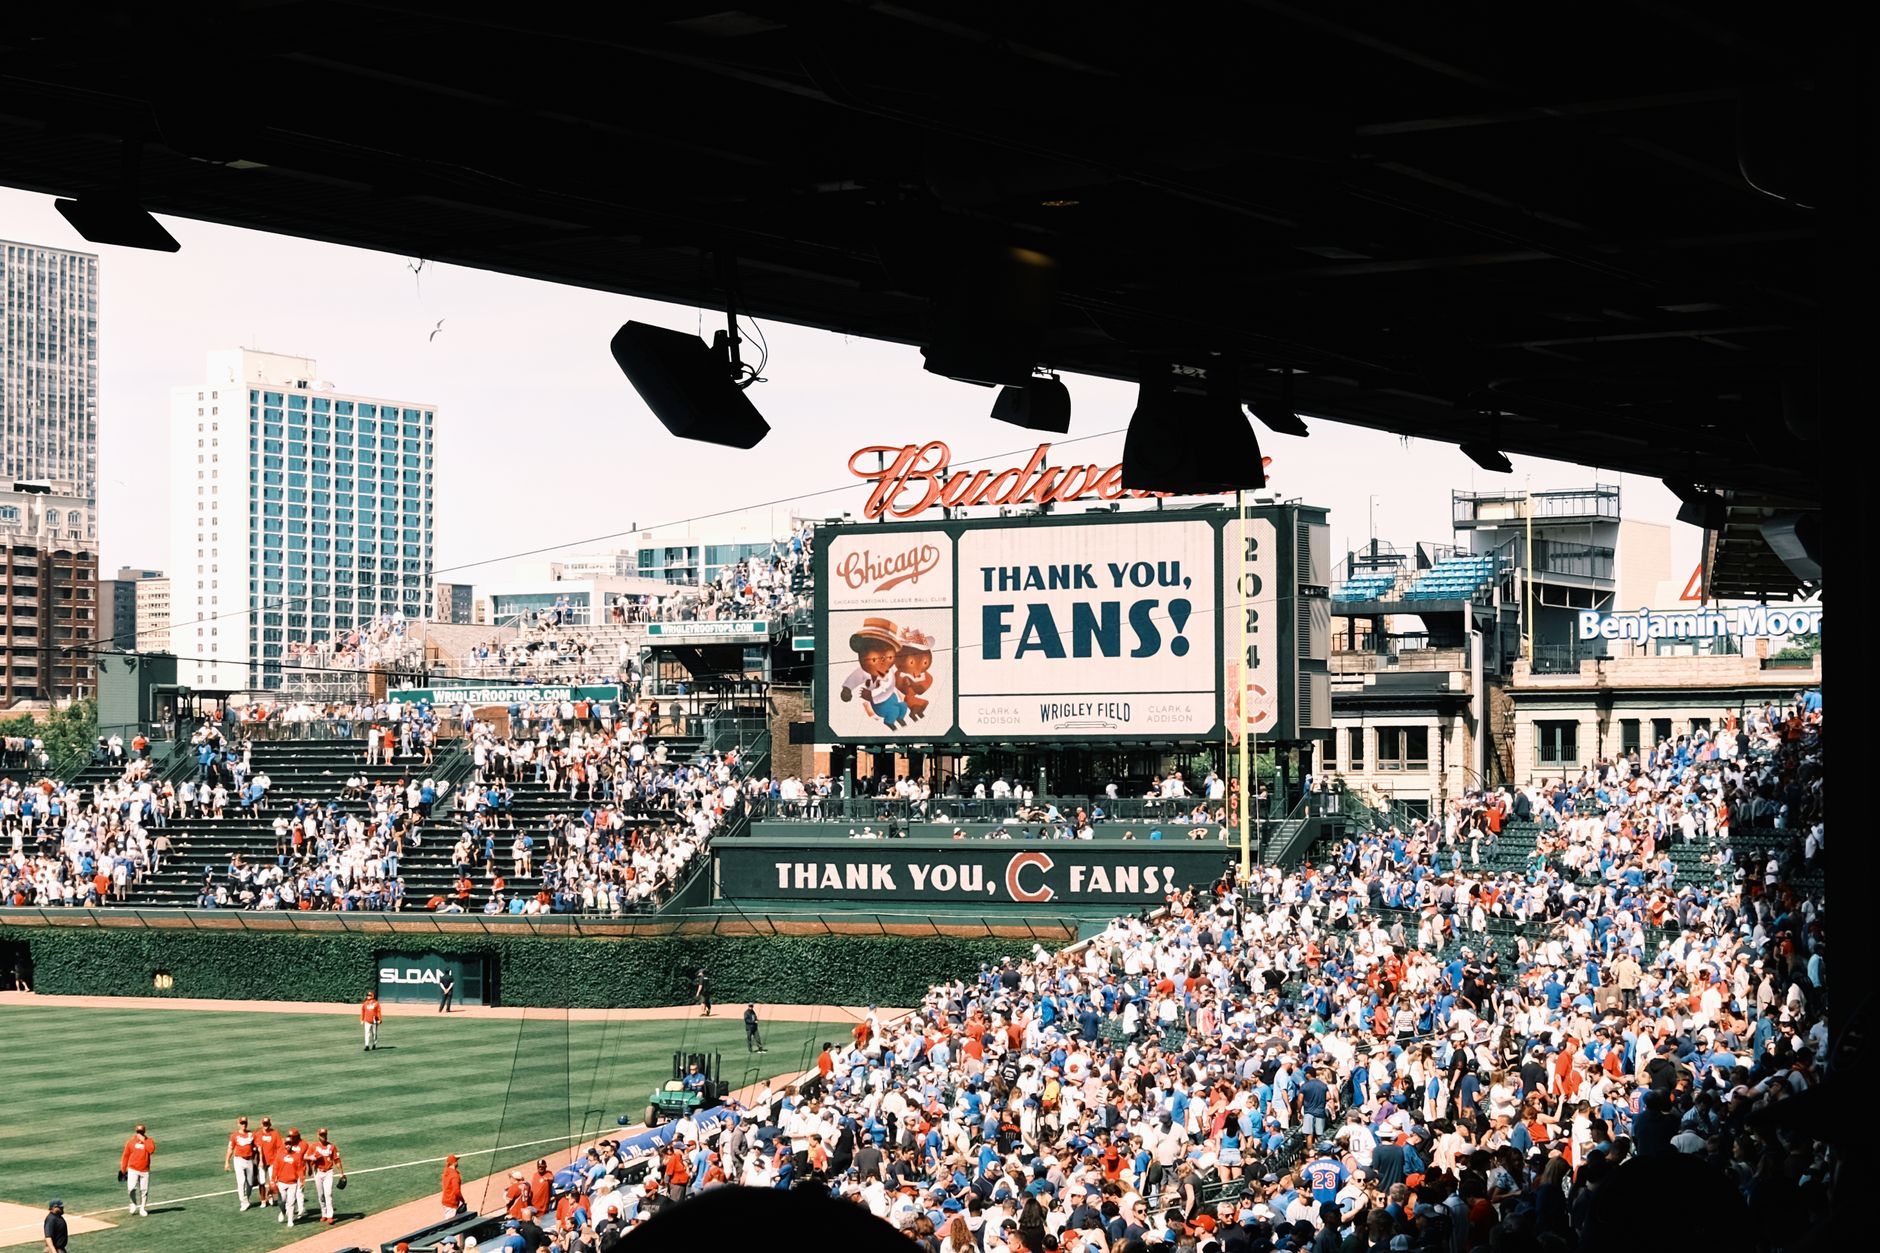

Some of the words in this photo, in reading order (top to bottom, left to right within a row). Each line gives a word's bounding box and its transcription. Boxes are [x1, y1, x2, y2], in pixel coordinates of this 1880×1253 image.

[848, 440, 1272, 520] Budwe
[836, 544, 940, 593] Chicago
[980, 563, 1098, 592] THANK
[1107, 560, 1192, 590] YOU,
[982, 598, 1192, 660] FANS!
[1578, 605, 1728, 647] Benjamin
[1736, 604, 1822, 637] Moor
[432, 688, 571, 703] WRIGLEYROOFTOPS.COM
[978, 707, 1010, 716] CLARK
[1040, 703, 1092, 723] WRIGLEY
[1097, 702, 1131, 722] FIELD
[1146, 714, 1193, 723] ADDISON
[1147, 705, 1182, 714] CLARK
[977, 717, 1021, 725] ADDISON
[775, 862, 897, 891] THANK
[907, 863, 997, 896] YOU,
[1070, 864, 1176, 895] FANS!
[1312, 1171, 1336, 1190] 23
